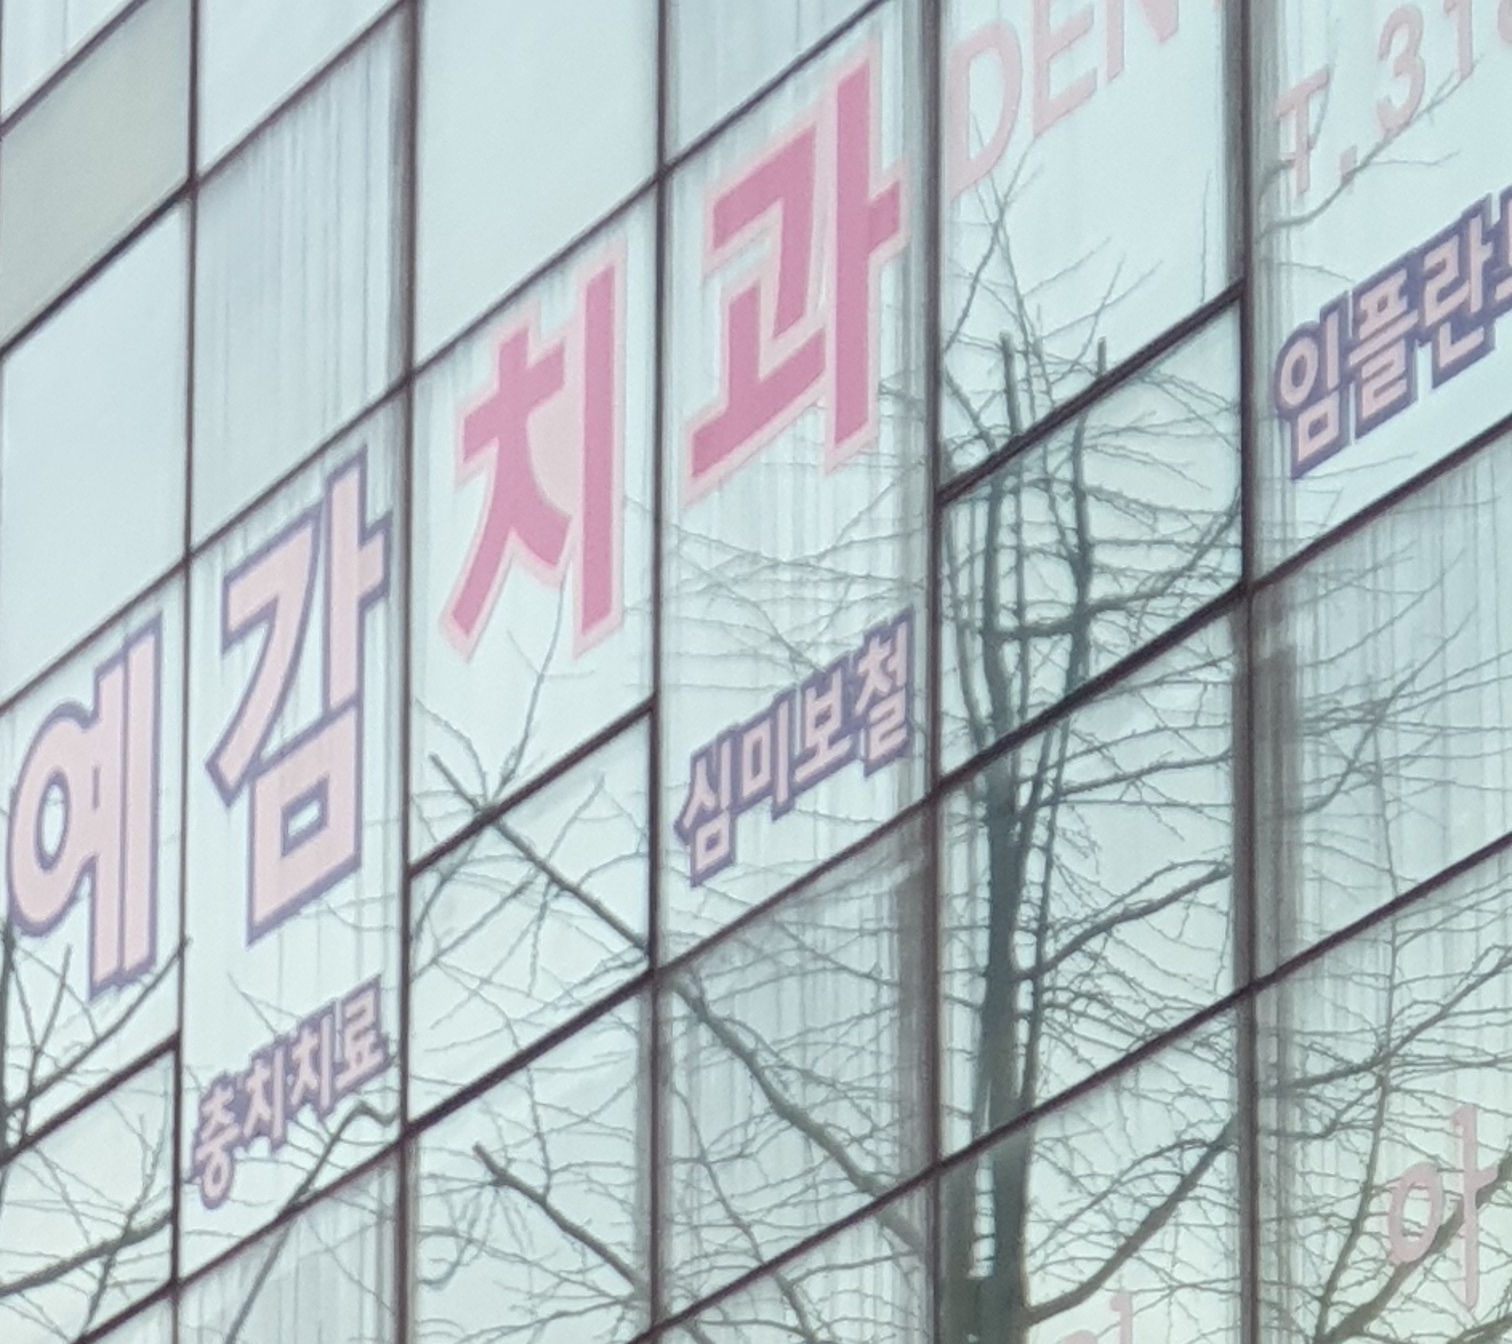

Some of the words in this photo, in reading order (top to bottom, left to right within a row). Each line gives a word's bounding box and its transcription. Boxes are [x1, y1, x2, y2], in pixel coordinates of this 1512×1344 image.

[1277, 0, 1512, 198] T.31
[1274, 184, 1512, 482] 임플란
[673, 604, 916, 888] 심미보철
[190, 972, 394, 1212] 충치치료
